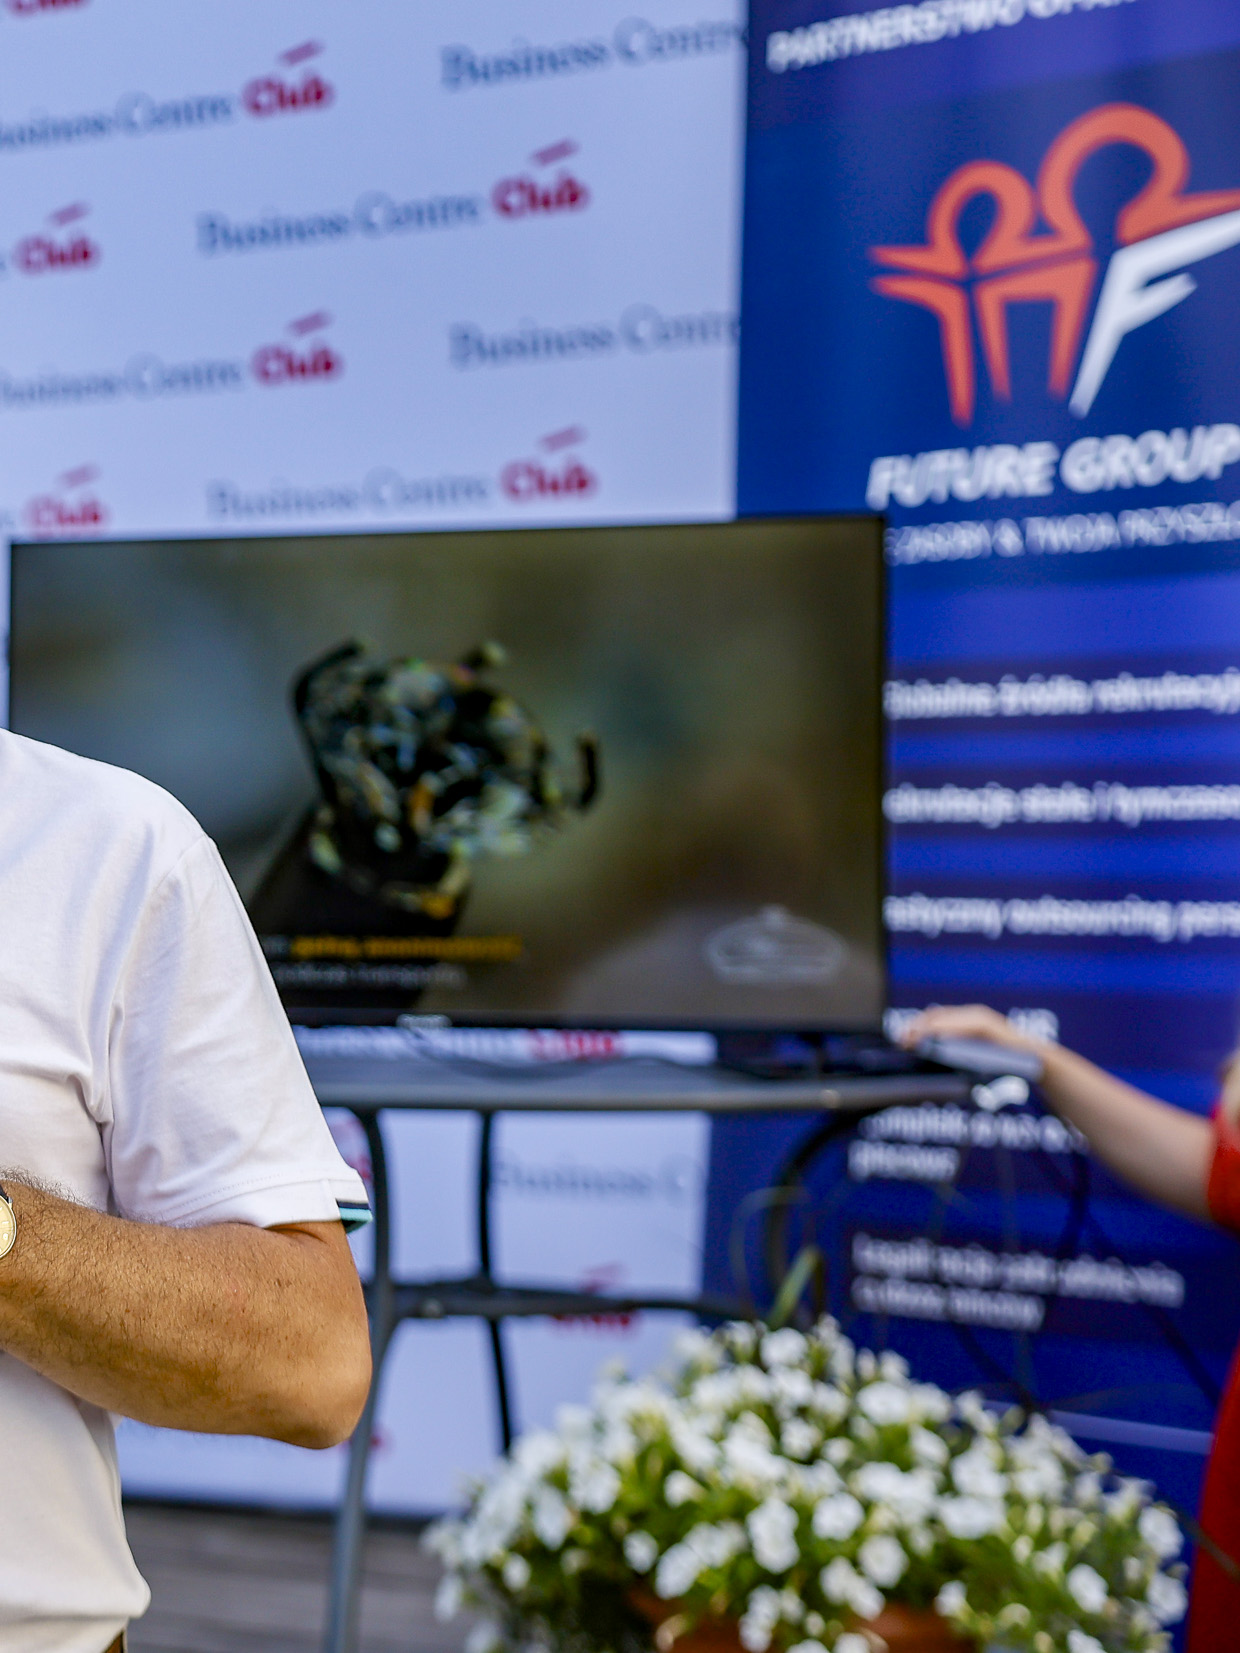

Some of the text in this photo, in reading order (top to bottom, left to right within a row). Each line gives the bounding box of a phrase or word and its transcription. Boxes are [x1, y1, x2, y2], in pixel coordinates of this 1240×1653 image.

[440, 33, 612, 93] Business
[117, 92, 237, 139] Centre
[240, 69, 335, 121] Club
[197, 167, 590, 258] Business Centre Club
[14, 229, 100, 278] Club
[126, 354, 248, 400] Centre
[251, 338, 344, 389] Club
[449, 319, 617, 371] Business
[207, 456, 598, 522] Business Centre Club
[867, 425, 1240, 509] FUTURE GROUP
[25, 491, 110, 532] Club
